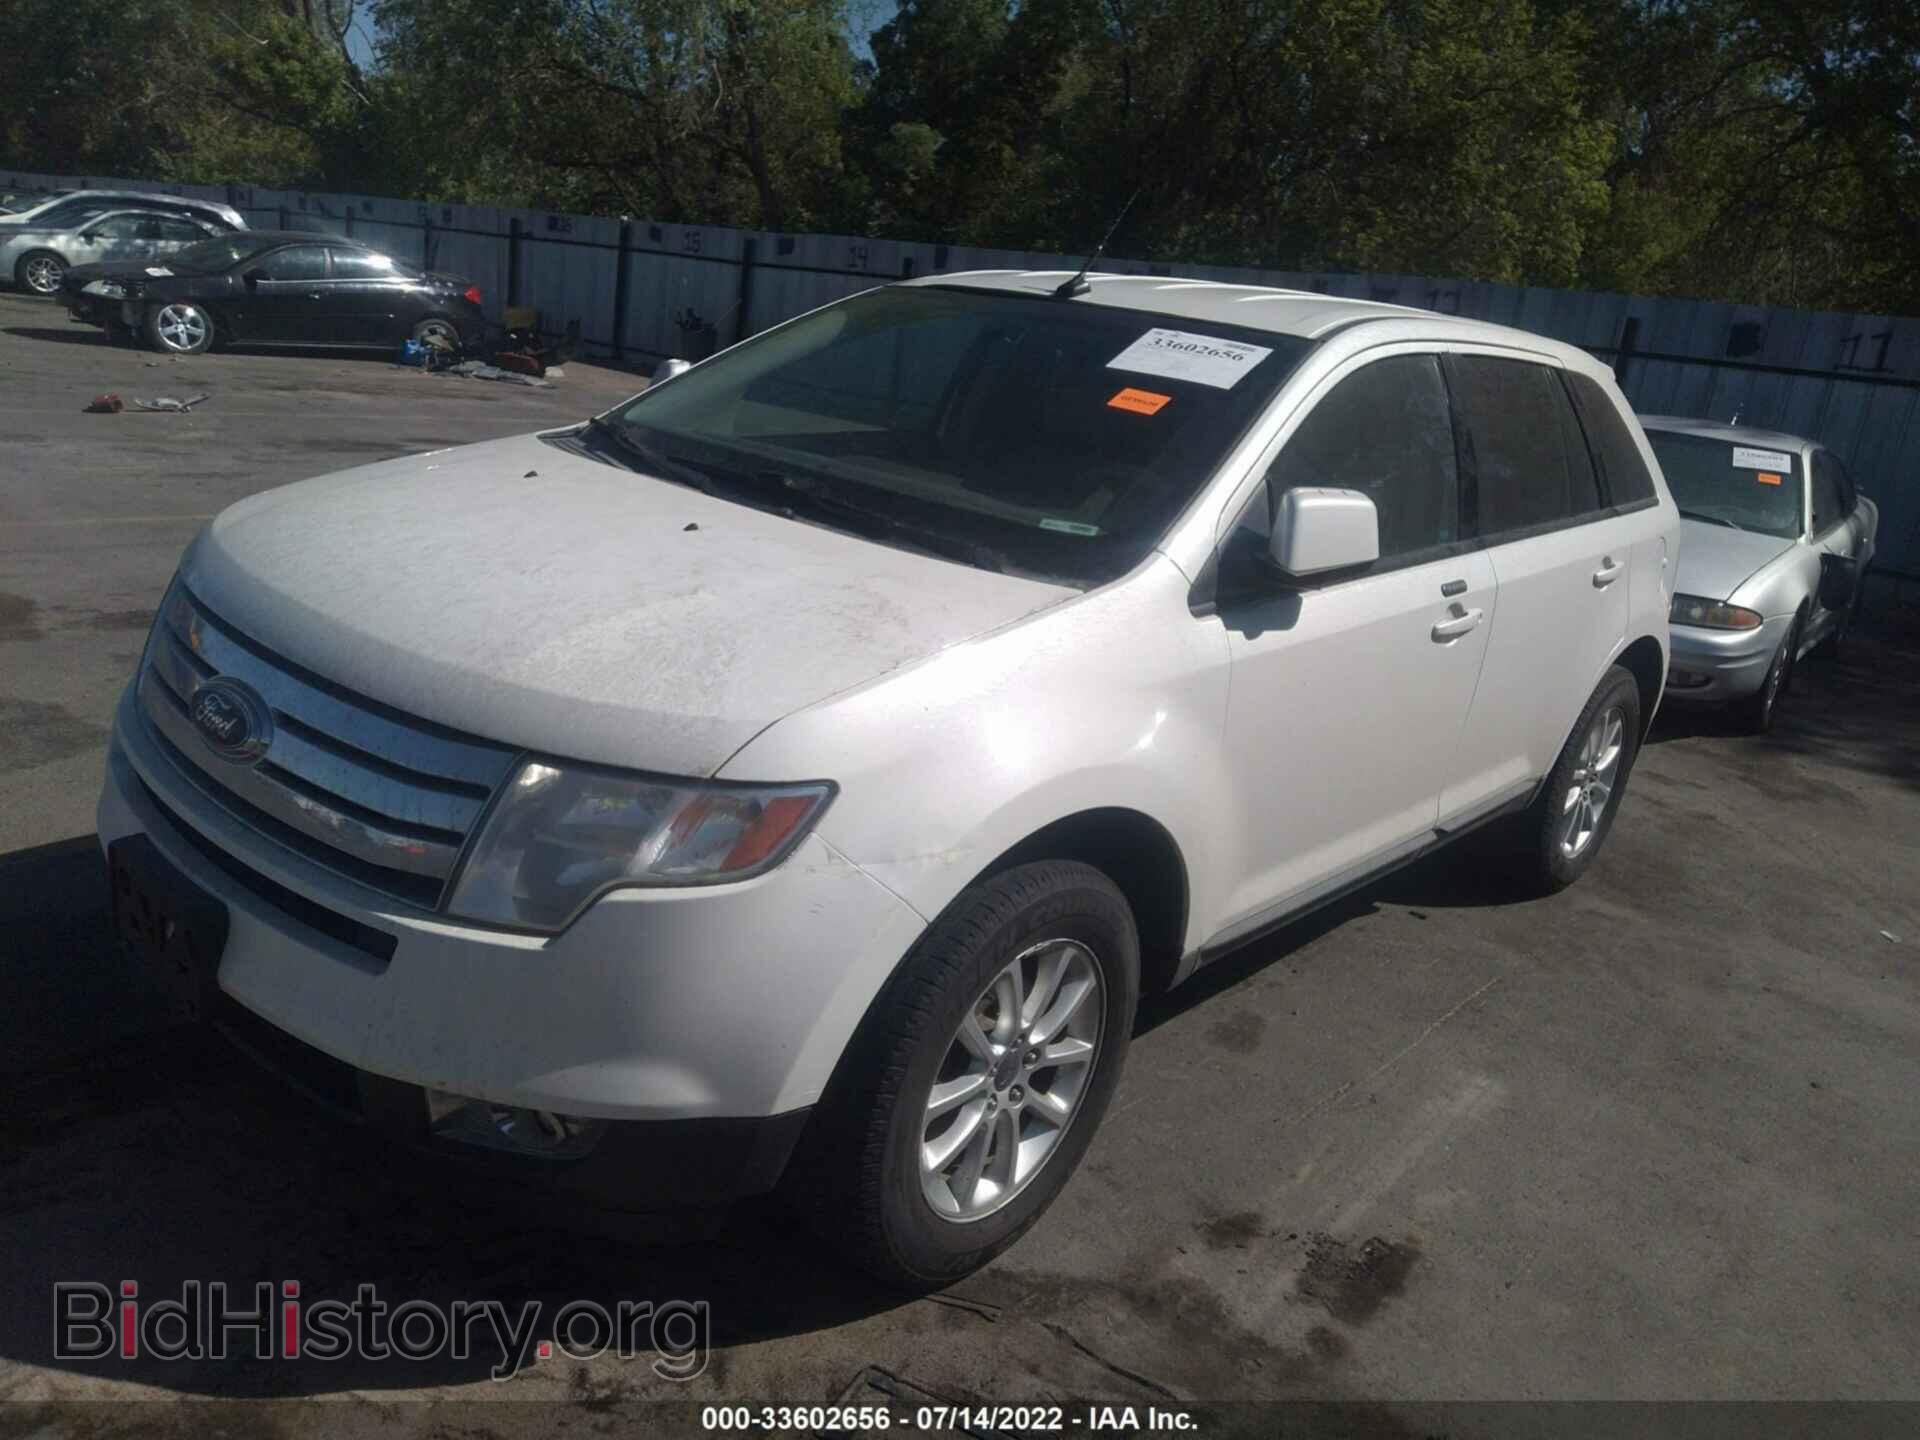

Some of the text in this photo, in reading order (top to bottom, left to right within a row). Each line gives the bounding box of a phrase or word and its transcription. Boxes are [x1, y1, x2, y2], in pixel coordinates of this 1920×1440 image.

[1148, 337, 1246, 362] 33602656
[1833, 330, 1895, 373] 11
[195, 693, 239, 739] Ford
